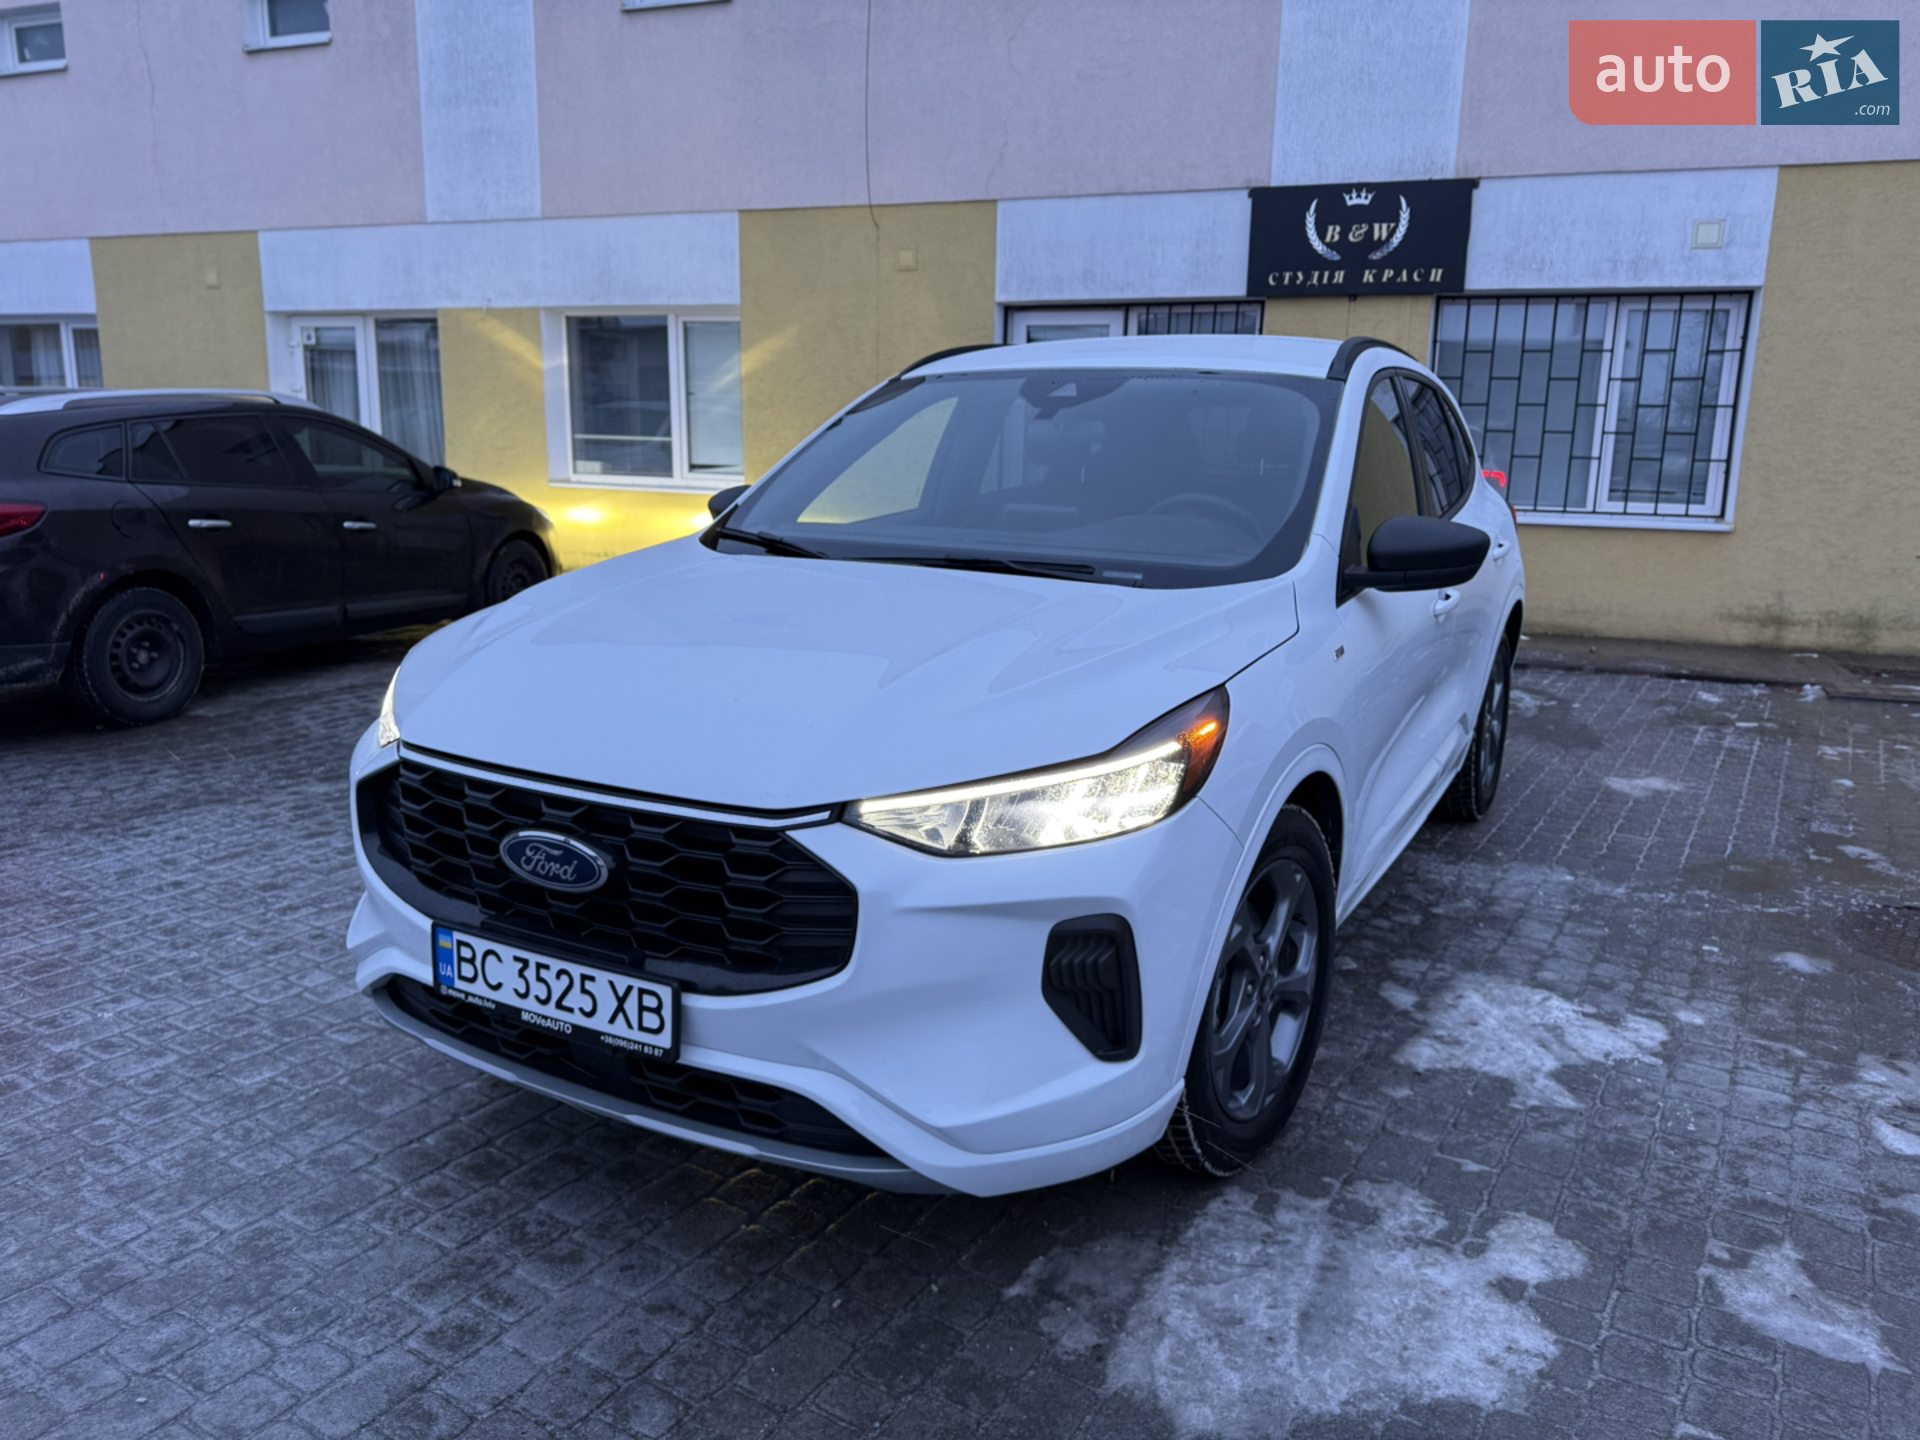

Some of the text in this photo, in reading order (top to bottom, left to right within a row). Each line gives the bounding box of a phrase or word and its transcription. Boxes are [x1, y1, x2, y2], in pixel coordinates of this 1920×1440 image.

[1267, 268, 1444, 288] СТУДІЯ КРАСИ
[520, 842, 578, 882] Ford
[439, 962, 454, 979] UA
[455, 938, 666, 1036] BC 3525 XB
[520, 1010, 573, 1035] MOVeAUTO
